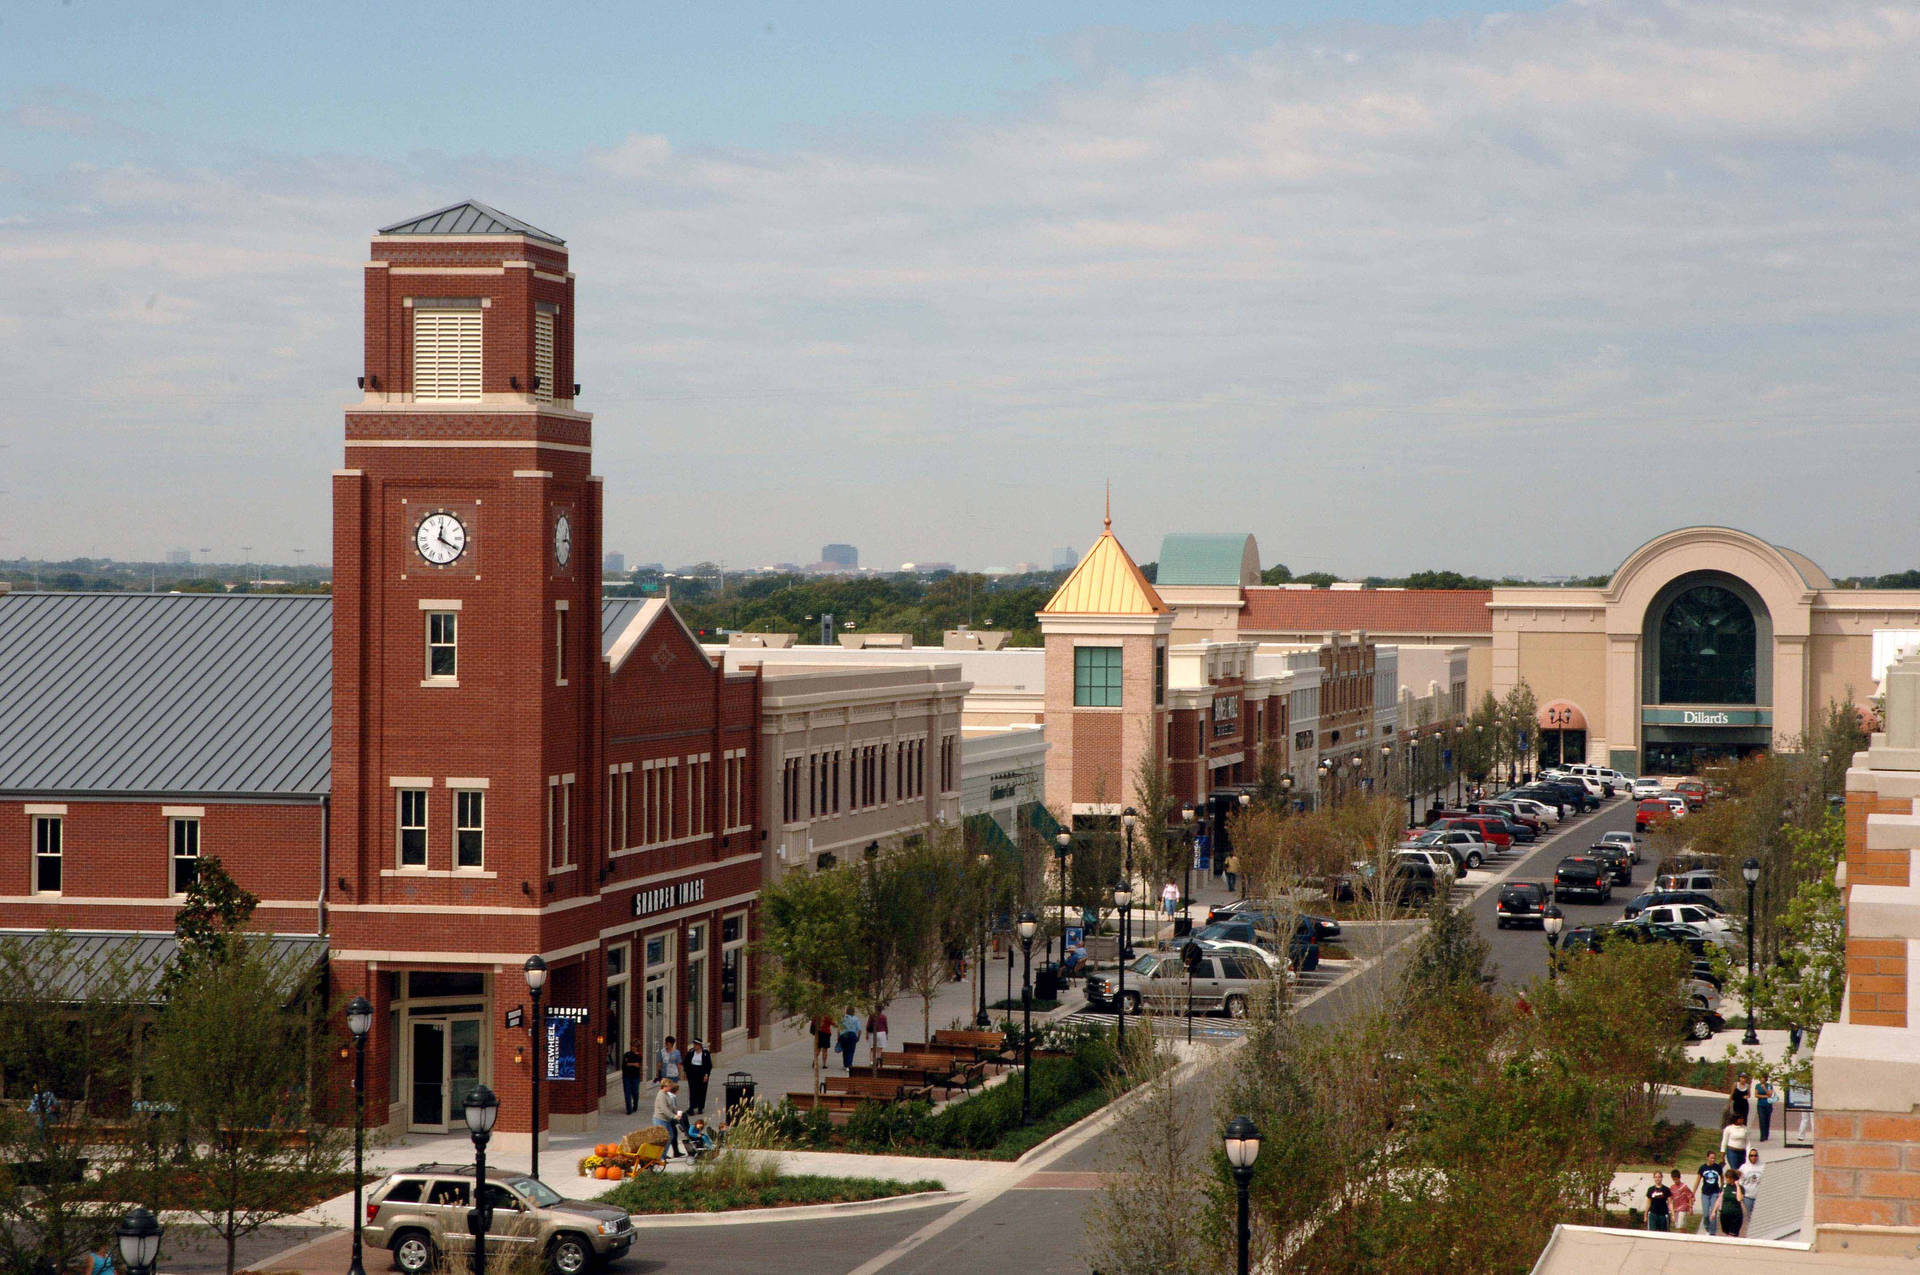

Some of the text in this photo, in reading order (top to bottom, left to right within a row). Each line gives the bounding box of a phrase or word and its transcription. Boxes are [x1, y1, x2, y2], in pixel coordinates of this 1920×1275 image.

[1683, 711, 1729, 724] Dillard's
[636, 878, 704, 915] SHARPER IMAGE
[547, 1023, 555, 1077] FIREWHEEL
